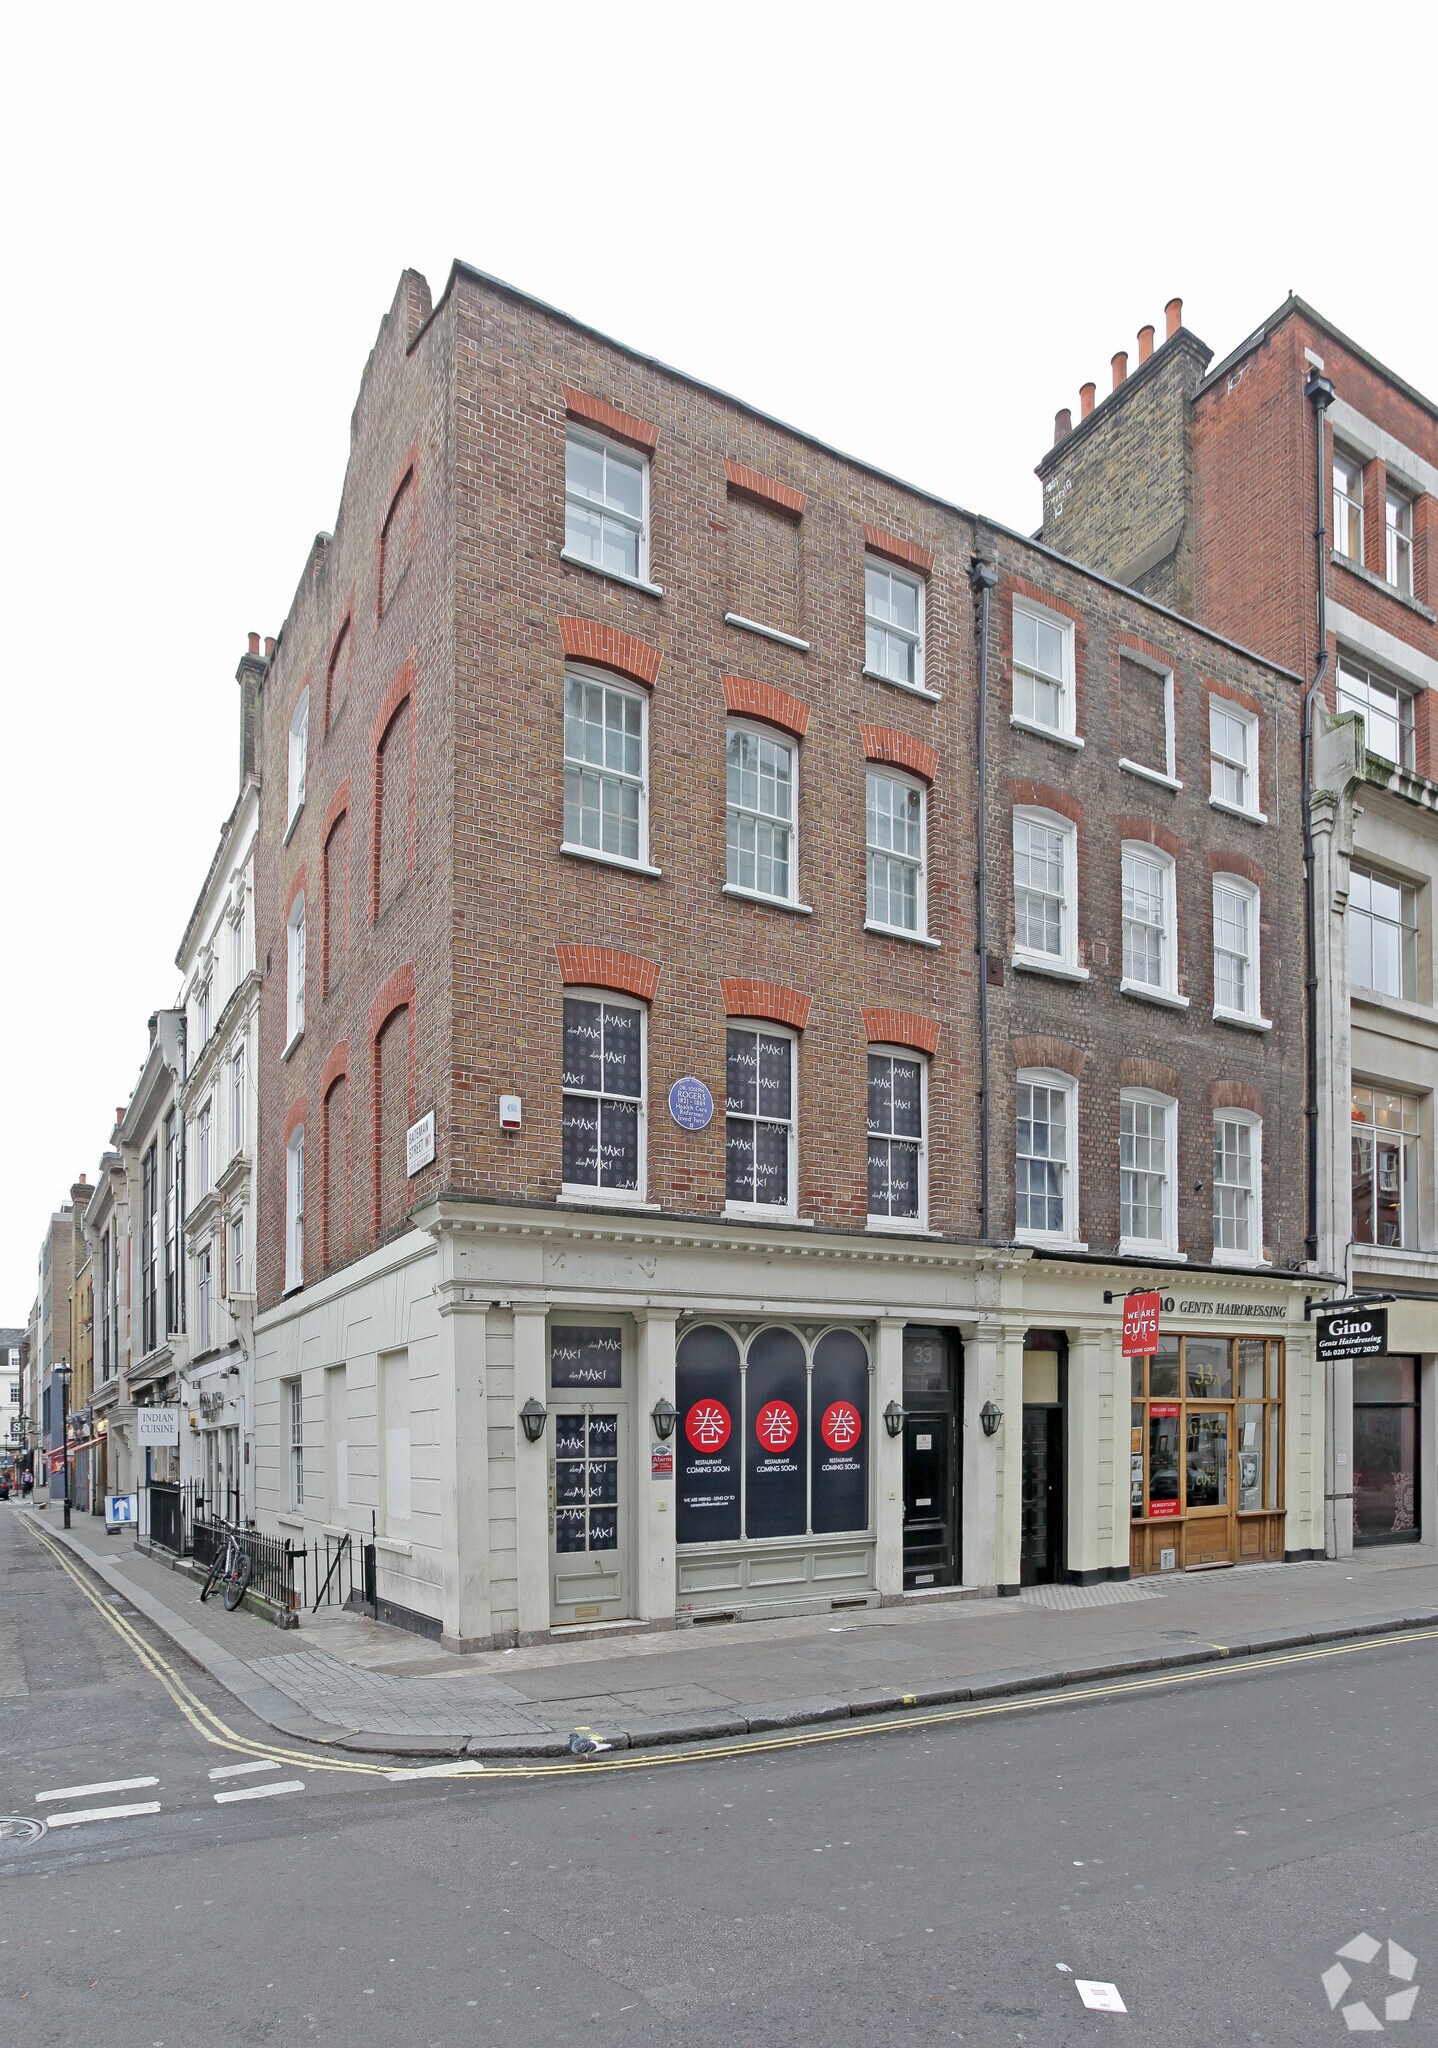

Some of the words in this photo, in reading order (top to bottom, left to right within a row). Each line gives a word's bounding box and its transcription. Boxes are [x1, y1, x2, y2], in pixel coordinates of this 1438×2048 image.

[677, 1090, 707, 1100] ROGERS
[675, 1103, 694, 1111] Health
[695, 1105, 707, 1113] Care
[408, 1119, 429, 1146] BATEMAN
[408, 1138, 424, 1160] STREET
[1127, 1311, 1139, 1320] WE
[1140, 1308, 1156, 1318] ARE
[1180, 1301, 1214, 1315] GENTS
[1216, 1303, 1286, 1318] HAIRDRESSING
[1124, 1320, 1157, 1335] CUTS
[1328, 1320, 1372, 1336] Gino
[1319, 1340, 1338, 1348] Gents
[1339, 1335, 1382, 1346] Hairdressing
[914, 1346, 932, 1363] 33
[1333, 1348, 1345, 1356] 020
[1346, 1347, 1361, 1355] 7437
[1363, 1345, 1379, 1353] 2029
[143, 1413, 174, 1422] INDIAN
[141, 1424, 176, 1433] CUISINE
[756, 1465, 780, 1473] COMING
[780, 1464, 798, 1472] SOON
[1196, 1475, 1216, 1486] CUTS
